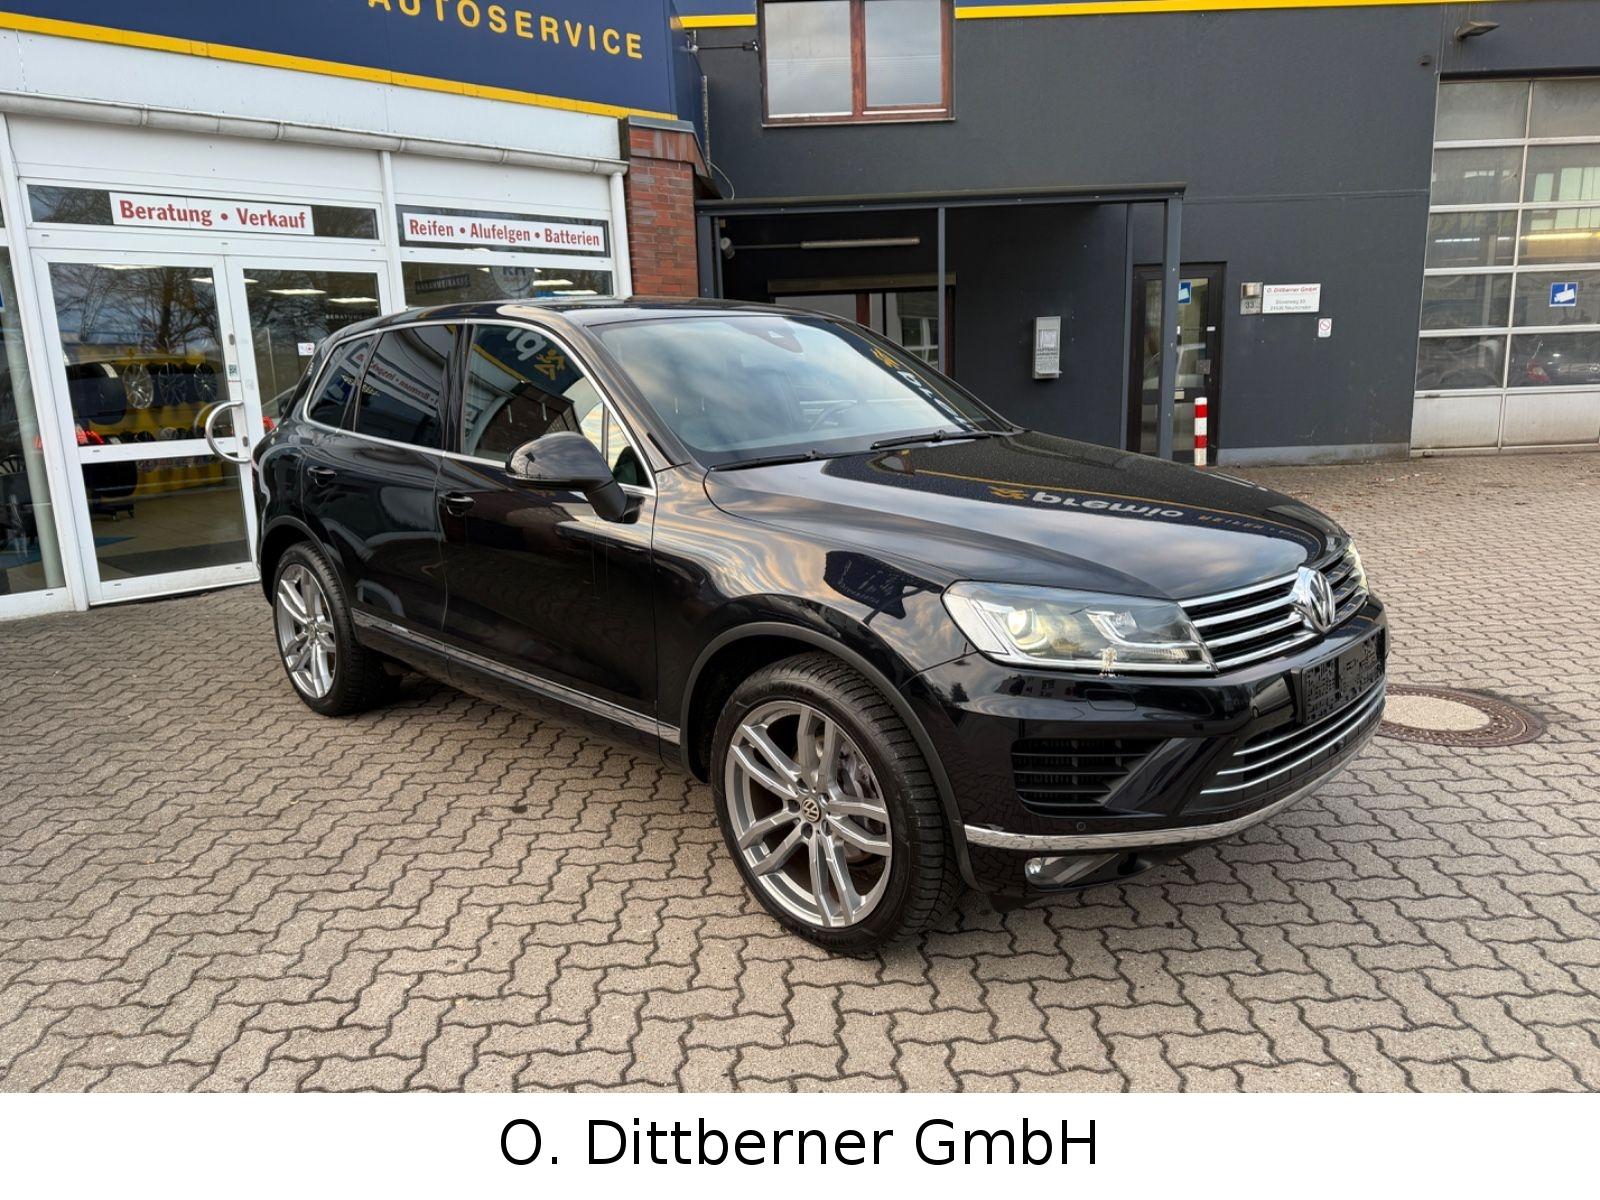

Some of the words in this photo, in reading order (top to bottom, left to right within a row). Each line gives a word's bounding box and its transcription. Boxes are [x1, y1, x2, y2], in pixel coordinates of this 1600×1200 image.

[119, 199, 213, 227] Beratung
[235, 207, 306, 229] Verkauf
[409, 219, 454, 237] Reifen
[470, 223, 531, 243] Alufelgen
[544, 228, 600, 246] Batterien
